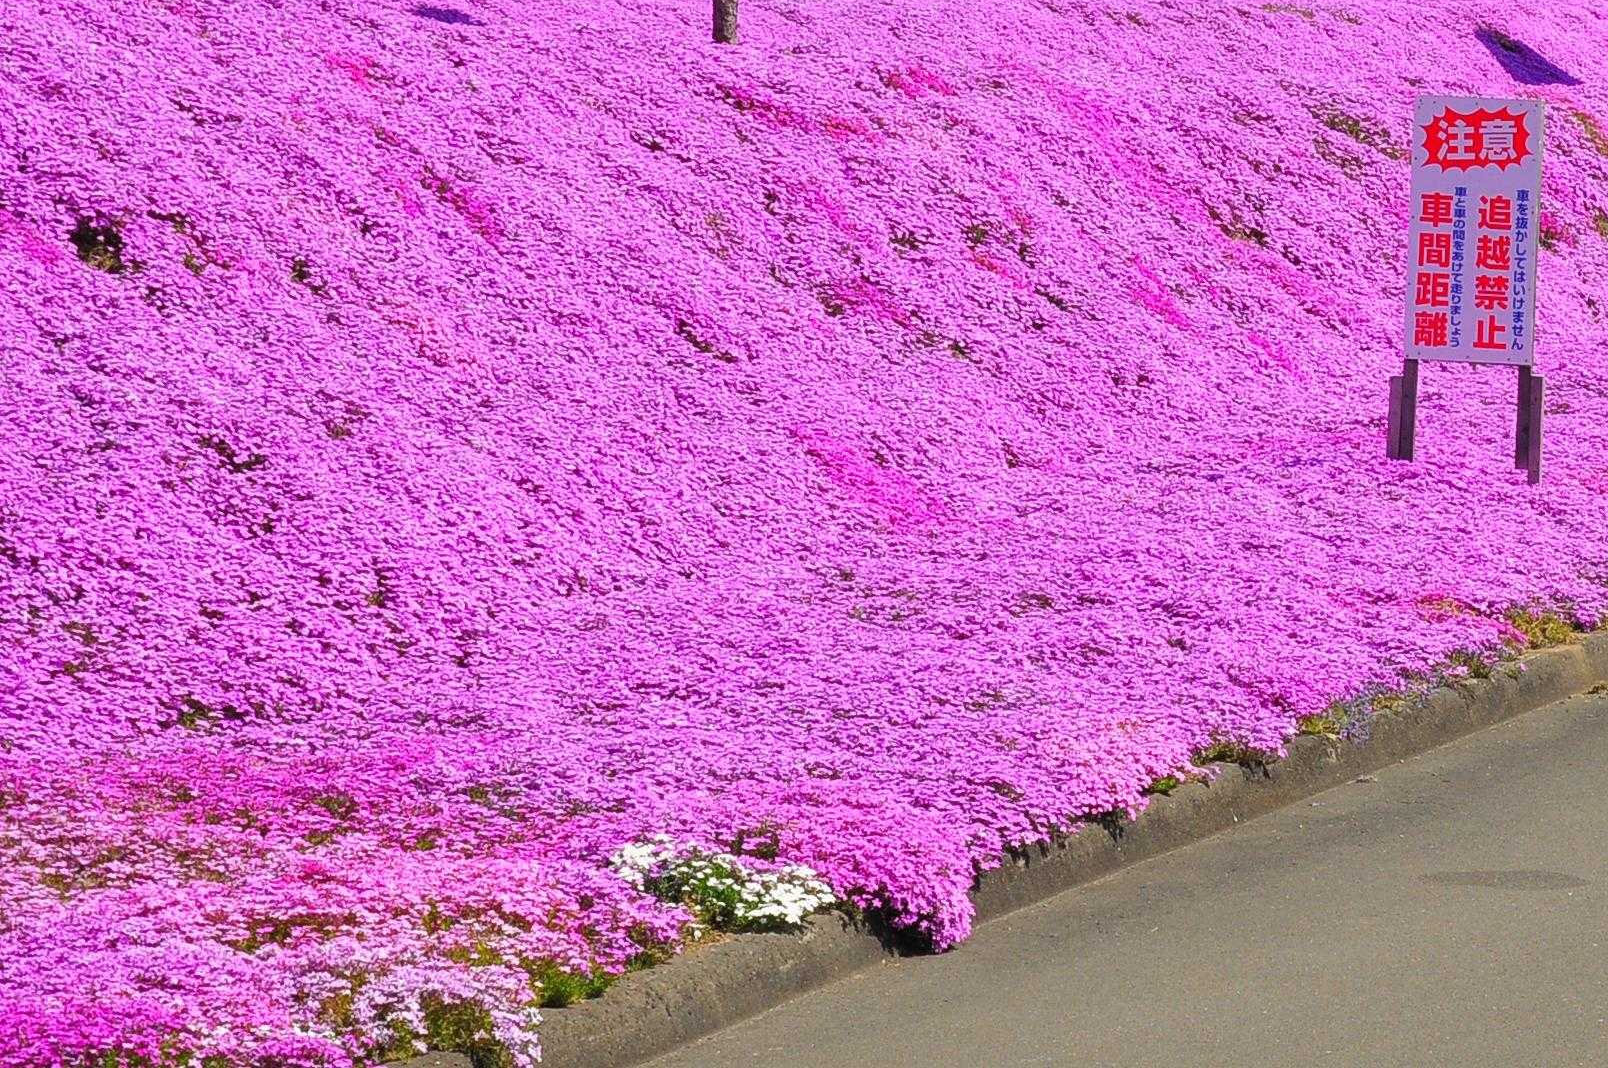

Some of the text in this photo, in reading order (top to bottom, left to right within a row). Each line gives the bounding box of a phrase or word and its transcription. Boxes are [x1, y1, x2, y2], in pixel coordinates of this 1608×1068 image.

[1438, 119, 1517, 161] 注意
[1414, 192, 1453, 347] 車間距離
[1473, 195, 1512, 350] 追越禁止
[1511, 189, 1530, 350] 車を抜かしてはいけません
